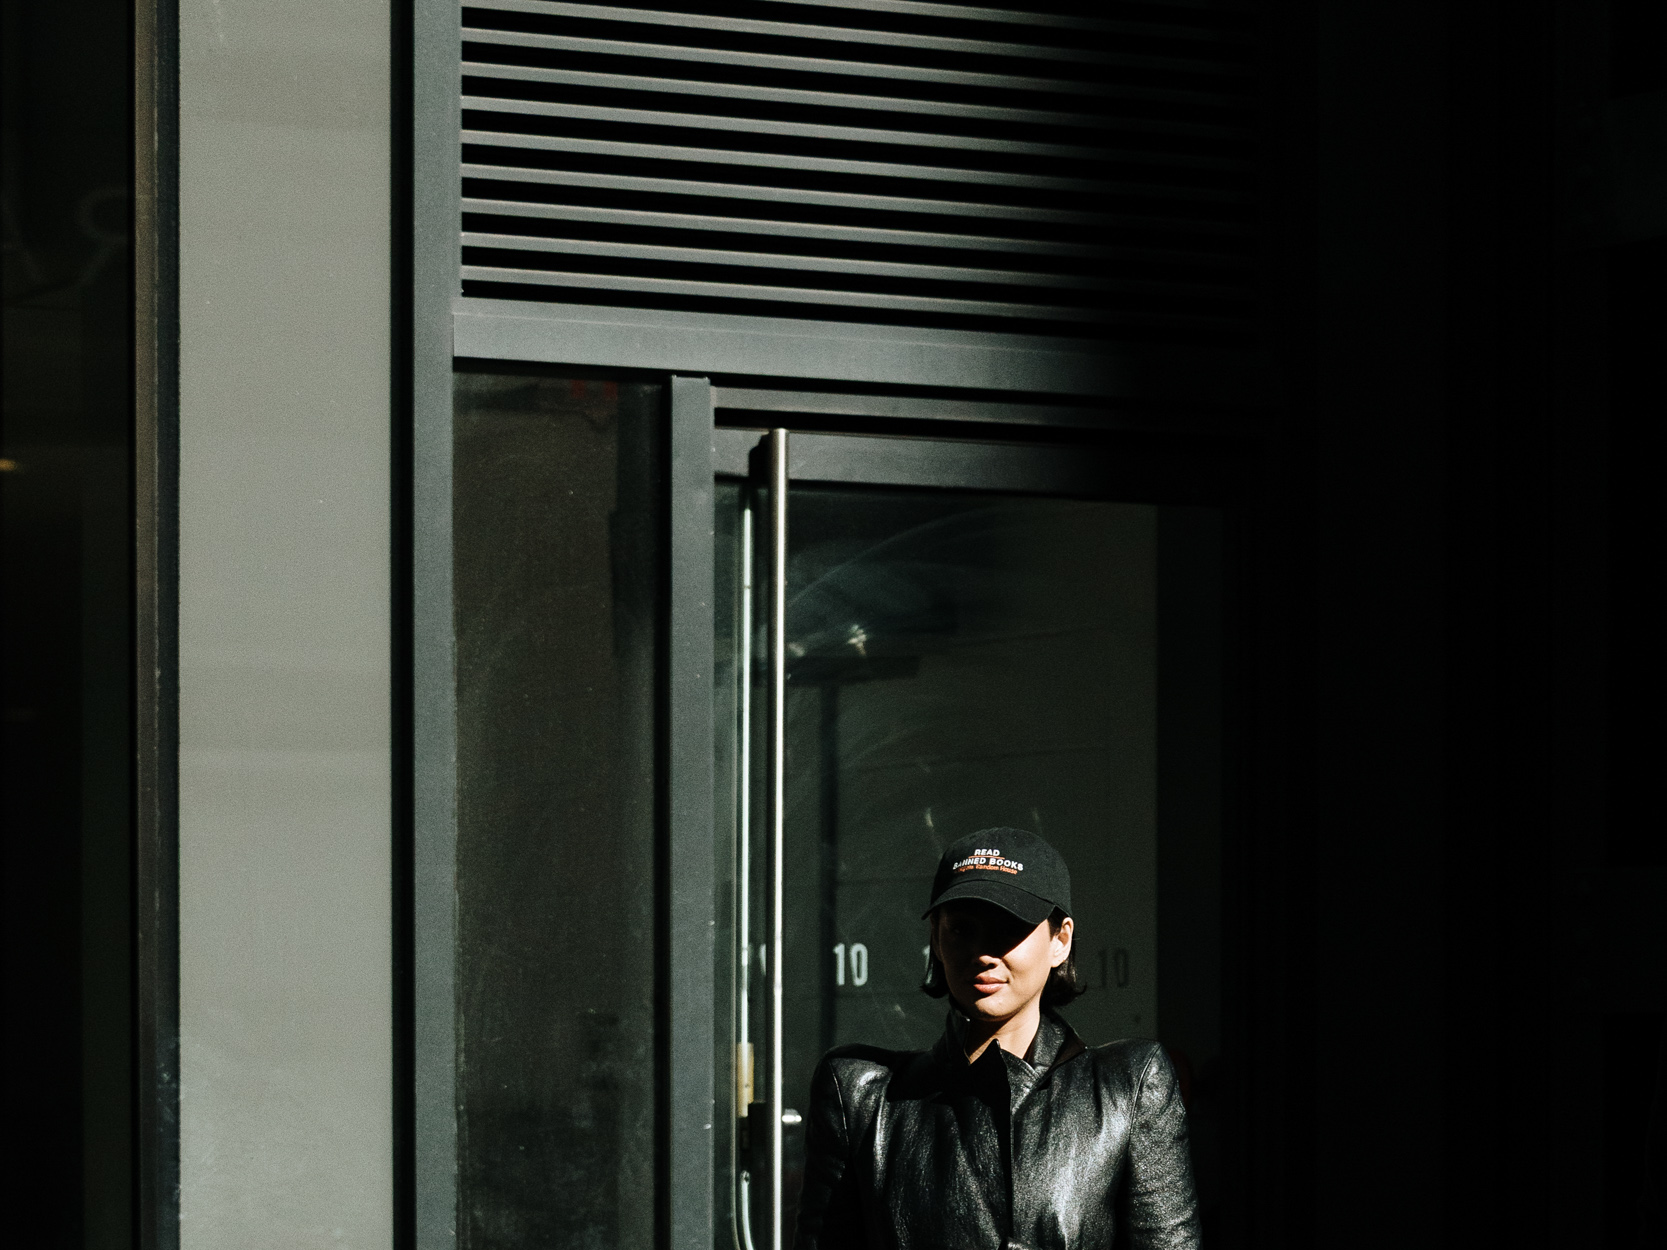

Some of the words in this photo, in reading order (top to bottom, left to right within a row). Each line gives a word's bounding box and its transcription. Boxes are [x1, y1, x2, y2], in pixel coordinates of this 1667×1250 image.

[974, 848, 1000, 856] READ
[953, 858, 987, 870] BANNED
[989, 858, 1024, 871] BOOKS
[833, 942, 869, 987] 10
